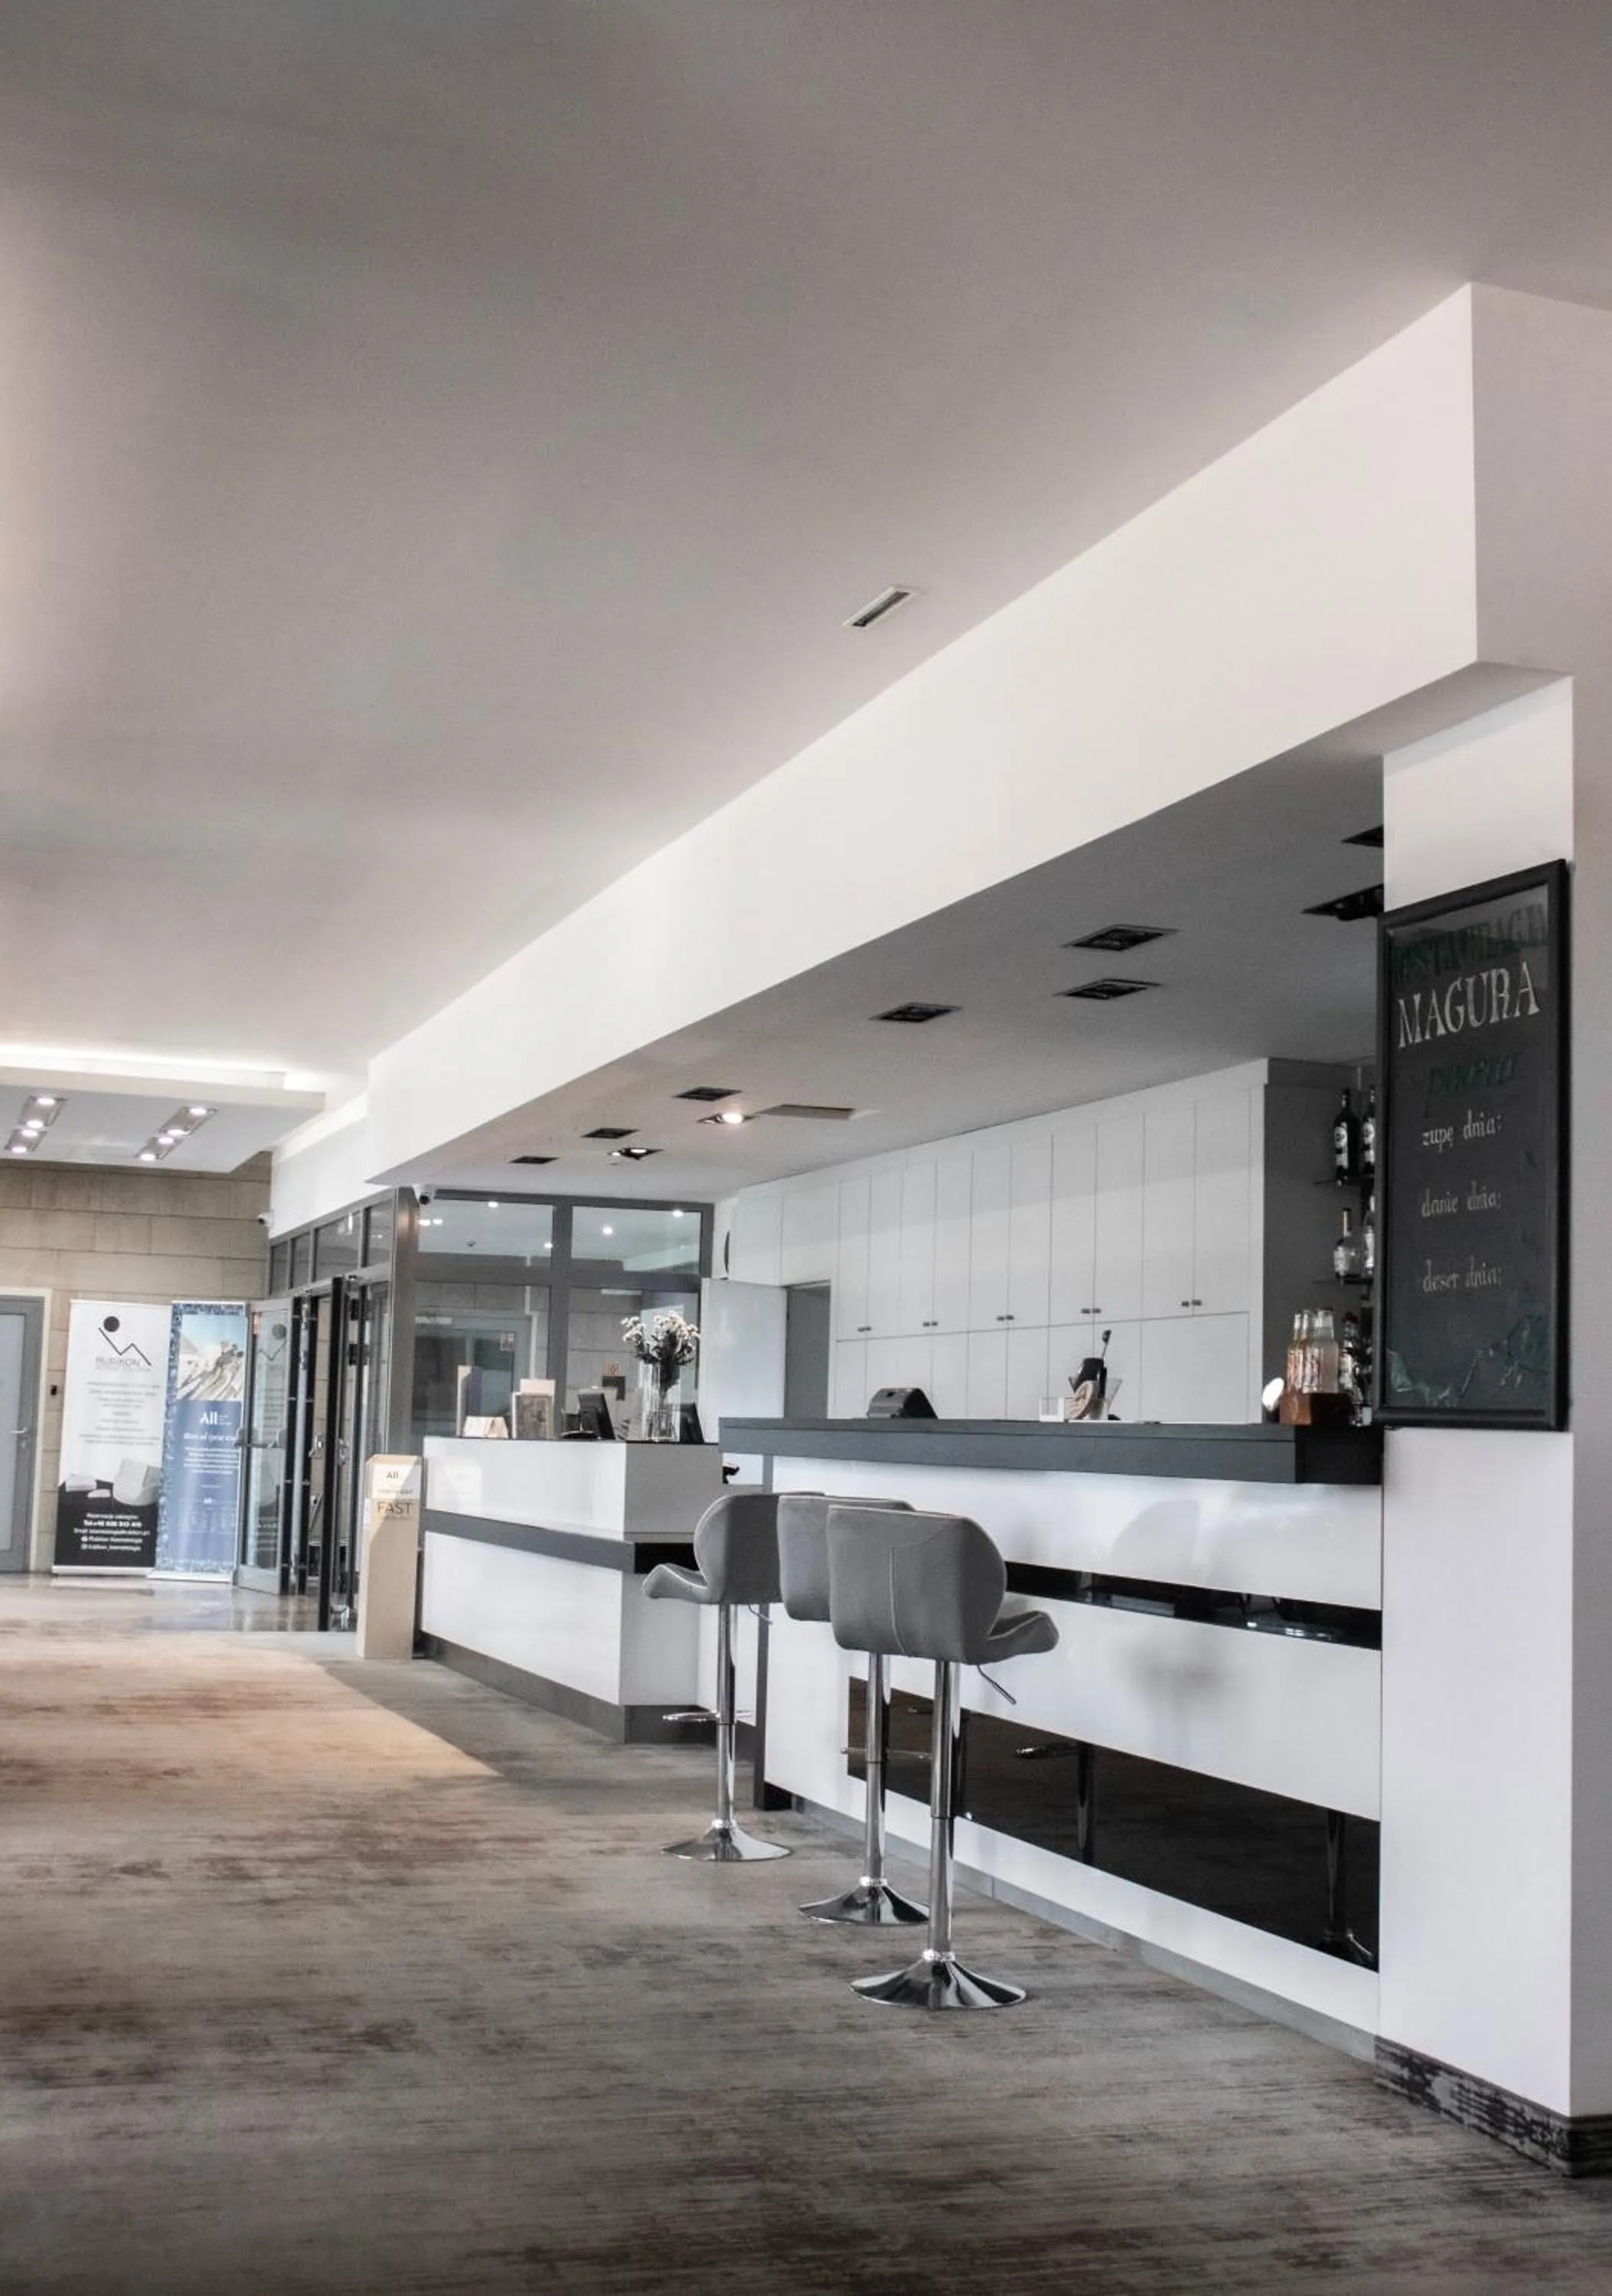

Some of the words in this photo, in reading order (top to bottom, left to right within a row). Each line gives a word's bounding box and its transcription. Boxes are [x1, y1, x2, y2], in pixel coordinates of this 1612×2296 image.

[1397, 960, 1542, 1051] MAGURA
[1464, 1109, 1503, 1140] dnia:
[1421, 1187, 1460, 1218] danie
[377, 1501, 416, 1515] FAST
